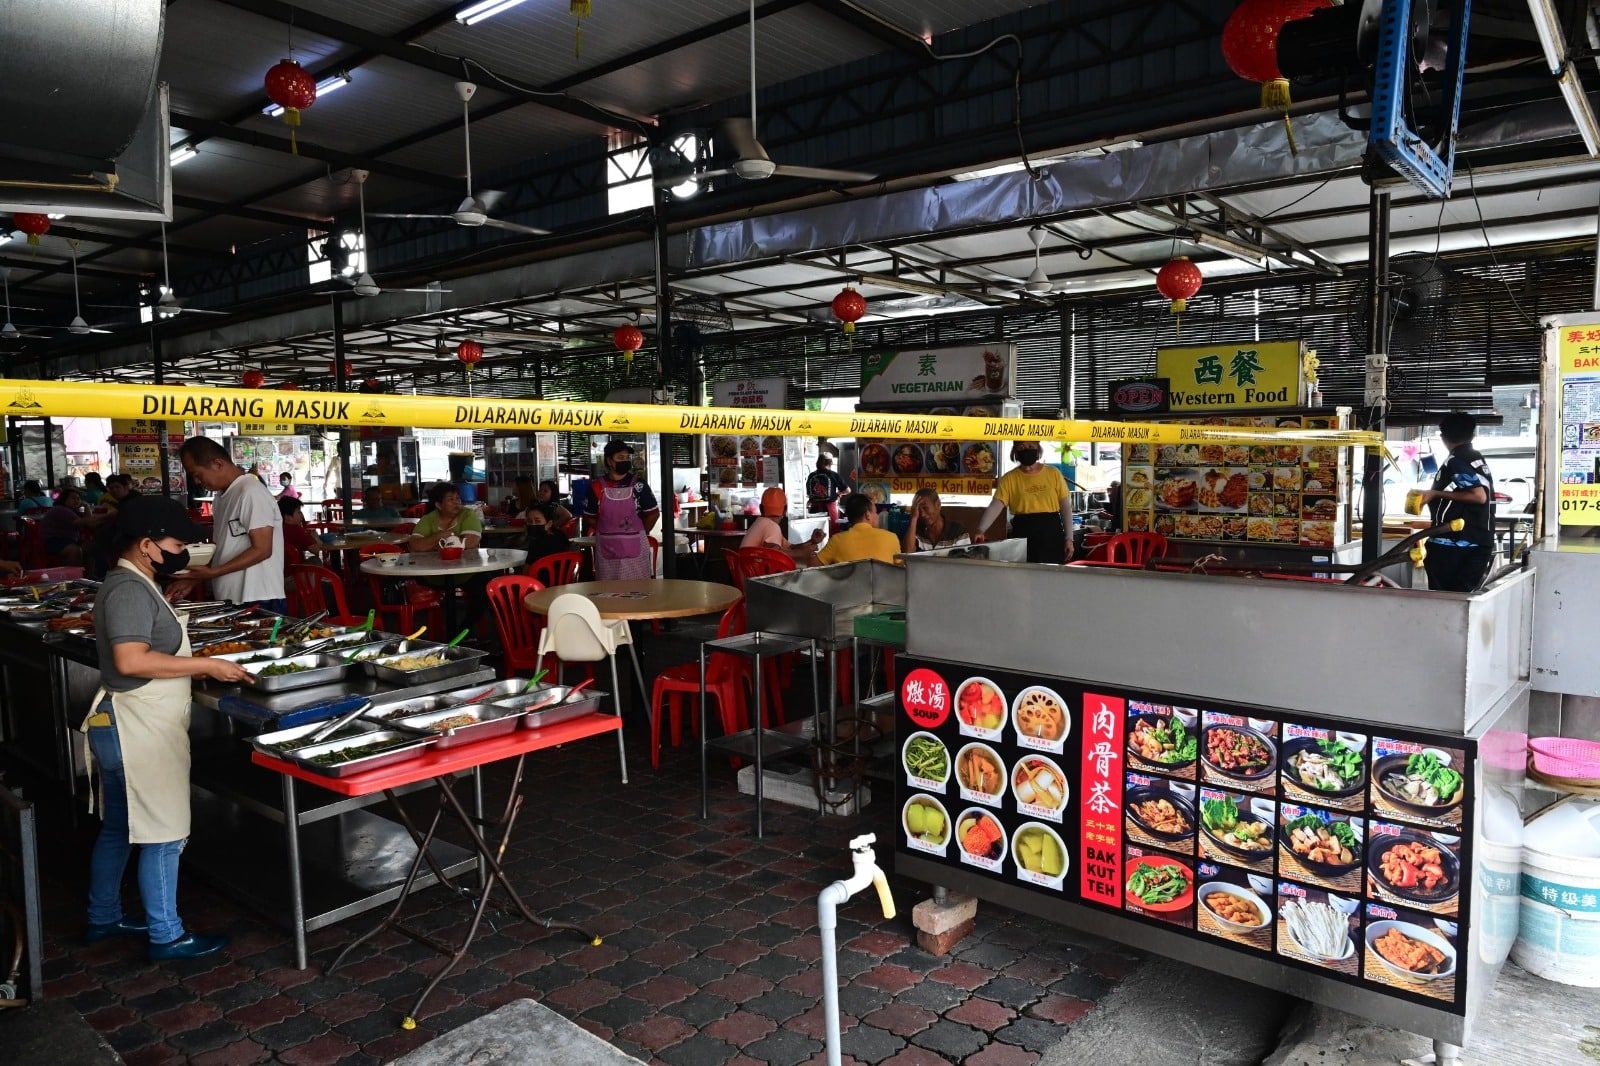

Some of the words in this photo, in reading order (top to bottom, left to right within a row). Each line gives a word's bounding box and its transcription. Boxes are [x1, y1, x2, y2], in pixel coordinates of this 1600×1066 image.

[917, 354, 937, 376] 素
[1194, 350, 1264, 388] 西餐
[1574, 357, 1600, 368] BAK
[891, 380, 963, 394] VEGETARIAN
[1114, 389, 1164, 405] OPEN
[1169, 391, 1235, 405] Western
[1244, 387, 1288, 403] Food
[143, 396, 264, 417] DILARANG
[274, 399, 350, 420] MASUK
[455, 407, 542, 425] DILARANG
[548, 411, 604, 427] MASUK
[680, 415, 745, 430] DILARANG
[750, 418, 792, 431] MASUK
[850, 420, 902, 433] DILARANG
[907, 421, 938, 434] MASUK
[984, 423, 1025, 436] DILARANG
[1028, 425, 1054, 437] MASUK
[1091, 426, 1126, 439] DILARANG
[1128, 428, 1151, 439] MASUK
[892, 479, 912, 491] Sup
[916, 479, 937, 490] Mee
[942, 479, 963, 492] Kari
[967, 481, 990, 493] Mee
[1562, 489, 1600, 497] 预订或打
[912, 707, 940, 721] SOUP
[1087, 702, 1119, 814] 肉骨茶
[1086, 819, 1116, 833] 三十年
[1086, 846, 1117, 866] BAK
[1086, 862, 1116, 881] KUT
[1087, 878, 1115, 898] TEH
[1541, 886, 1597, 907] 特级美
